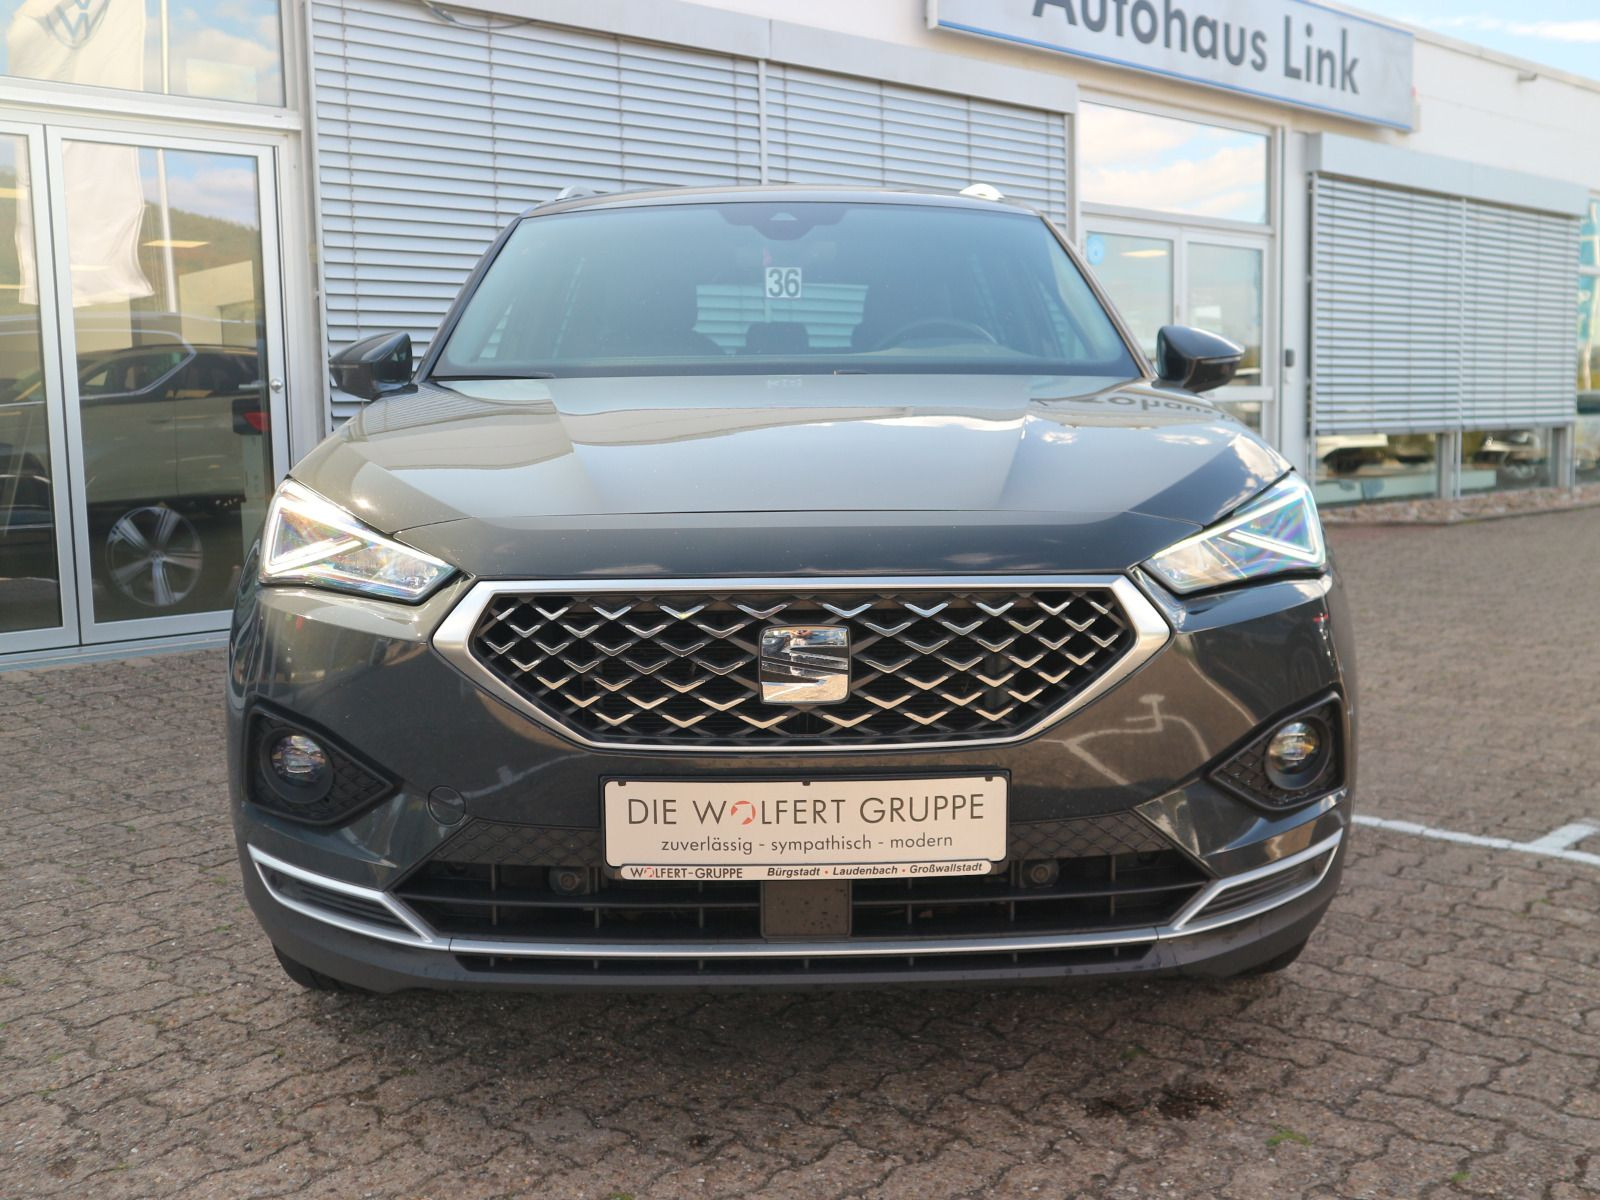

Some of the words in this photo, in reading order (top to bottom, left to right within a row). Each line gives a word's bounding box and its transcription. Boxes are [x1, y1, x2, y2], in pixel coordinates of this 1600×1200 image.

[1283, 14, 1360, 95] Link
[767, 268, 800, 298] 36
[628, 798, 677, 825] DIE
[692, 799, 846, 826] WOLFERT
[859, 793, 984, 824] GRUPPE
[661, 835, 752, 855] zuverlässig
[771, 834, 872, 854] sympathisch
[890, 832, 953, 849] modern
[630, 866, 743, 879] WOLFERT-GRUPPE
[767, 867, 821, 878] Bürgstadt
[833, 865, 898, 876] Laudenbach
[909, 863, 983, 874] Großwallstadt
